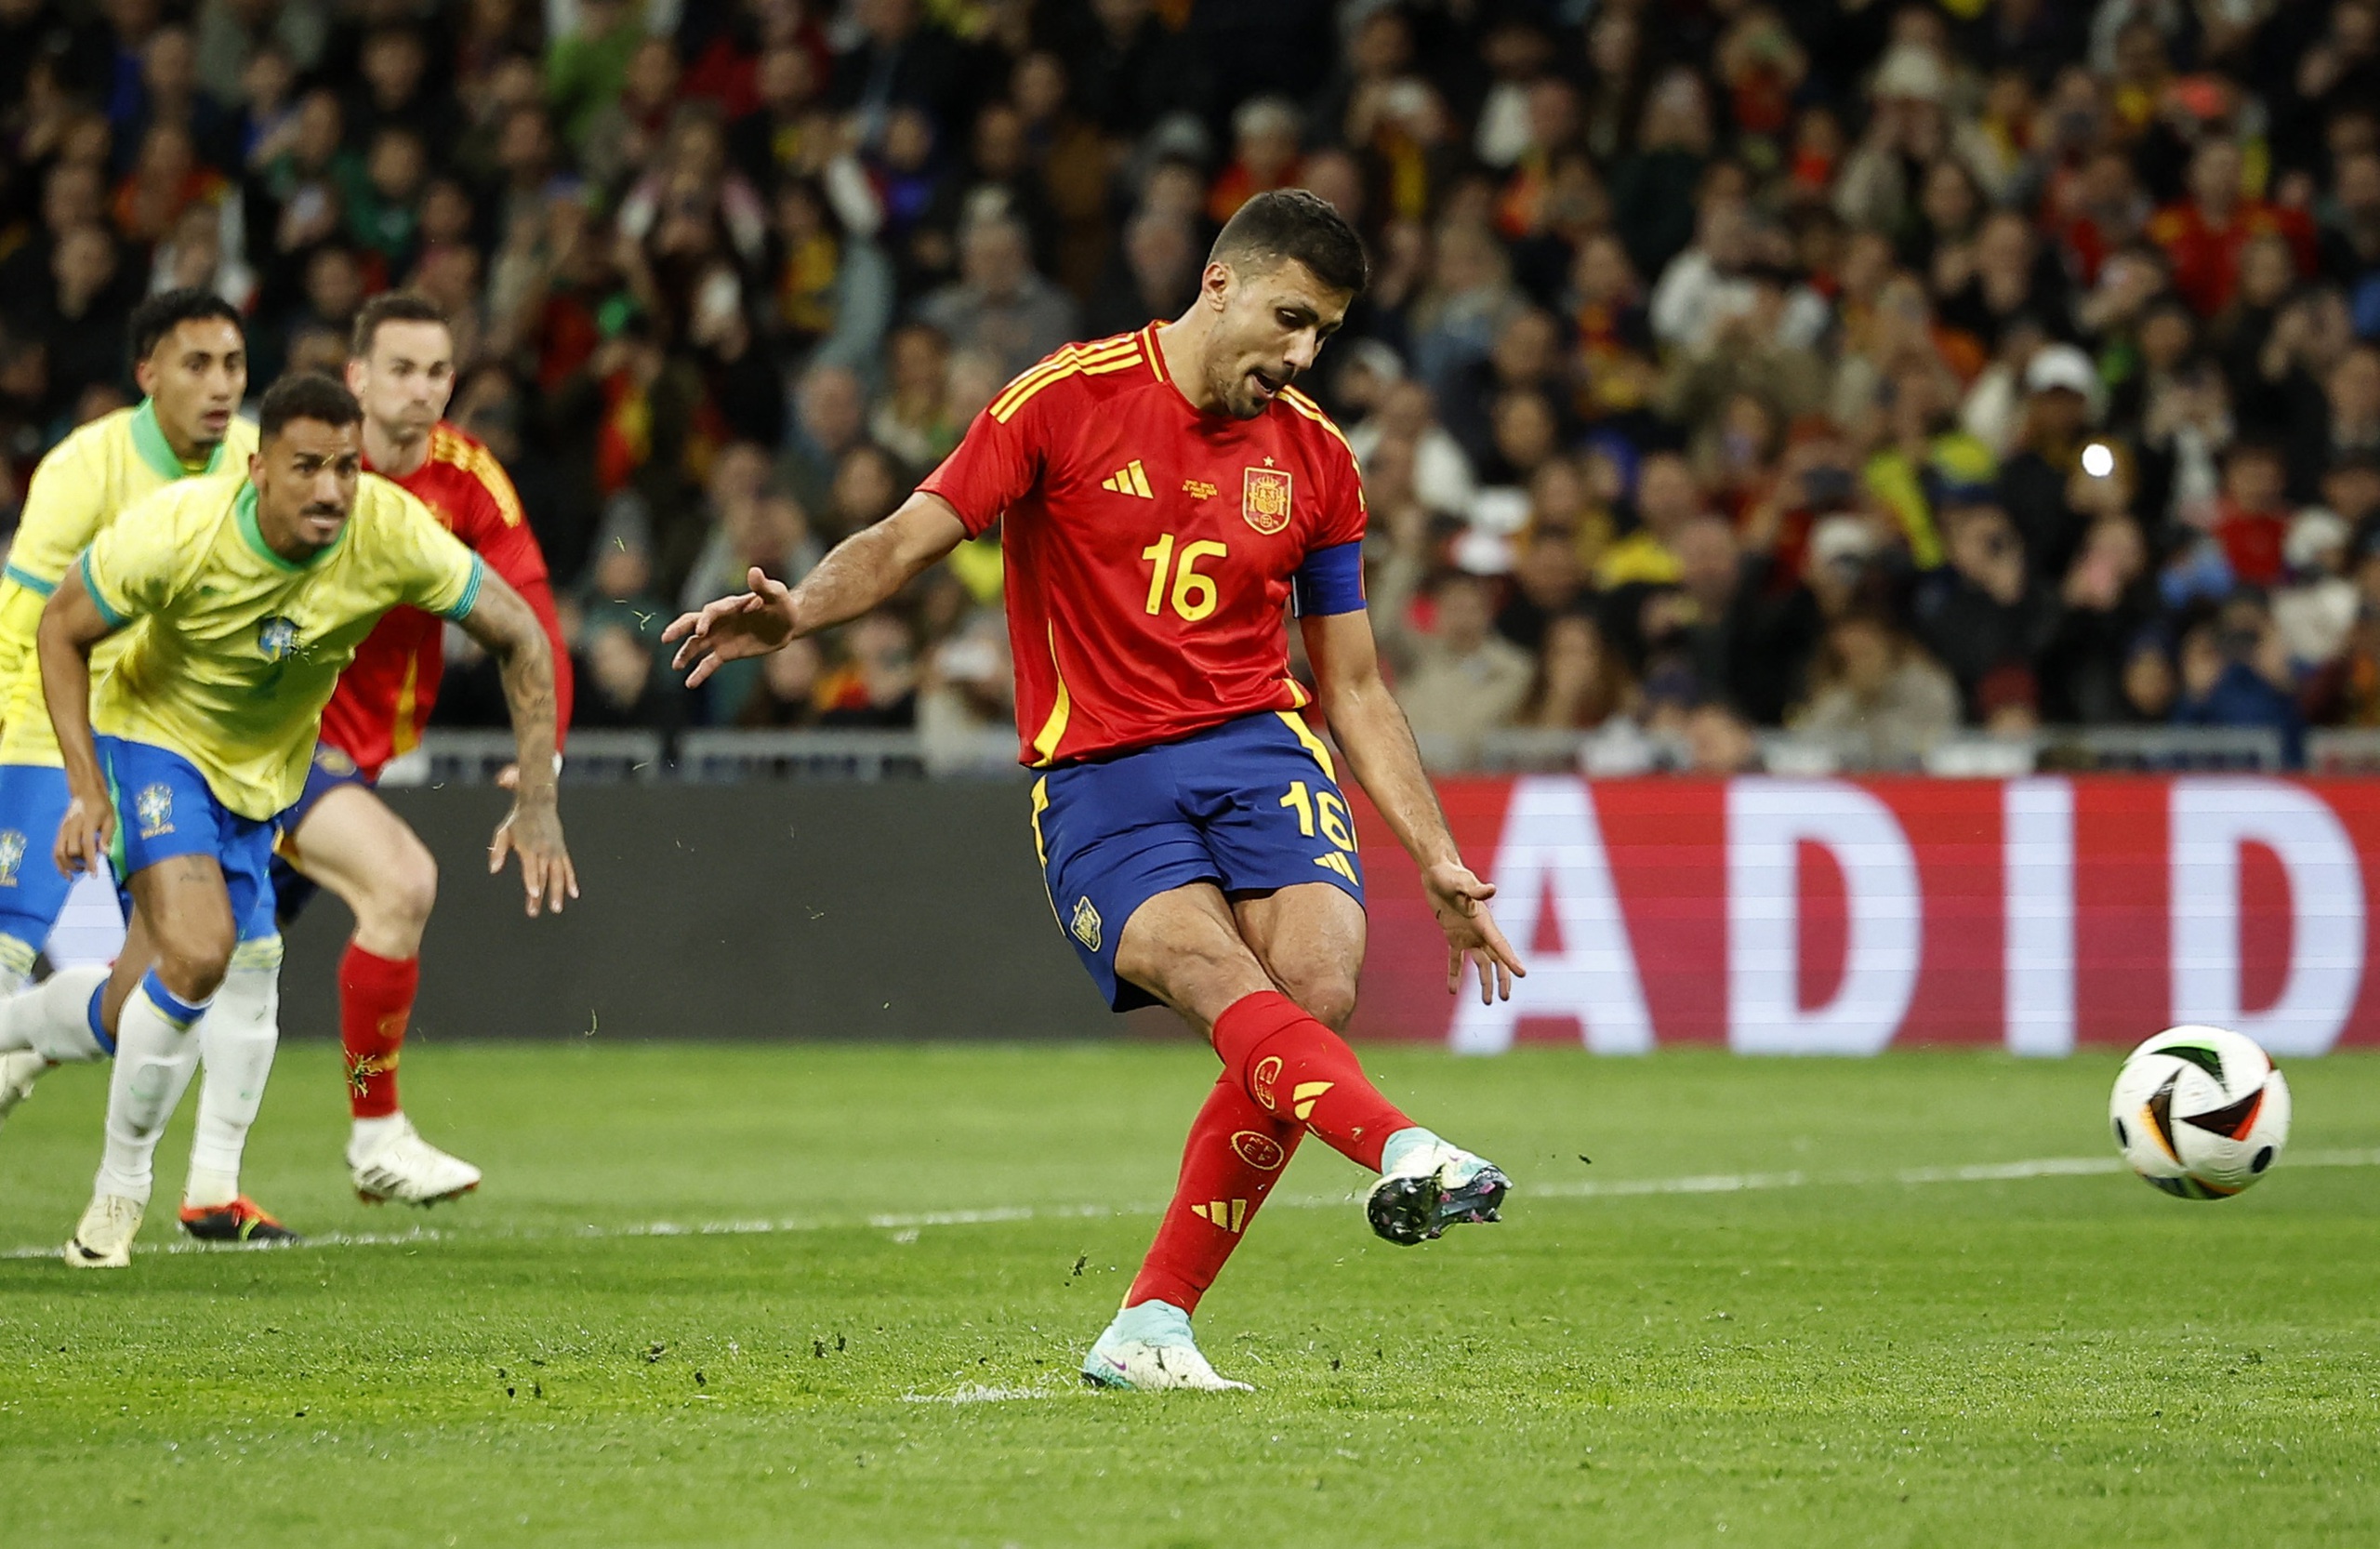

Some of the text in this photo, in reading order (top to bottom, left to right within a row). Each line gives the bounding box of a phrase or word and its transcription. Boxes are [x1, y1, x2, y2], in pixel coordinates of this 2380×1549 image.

[1142, 533, 1227, 621] 16
[1279, 781, 1354, 853] 16
[1449, 777, 2366, 1056] ADID
